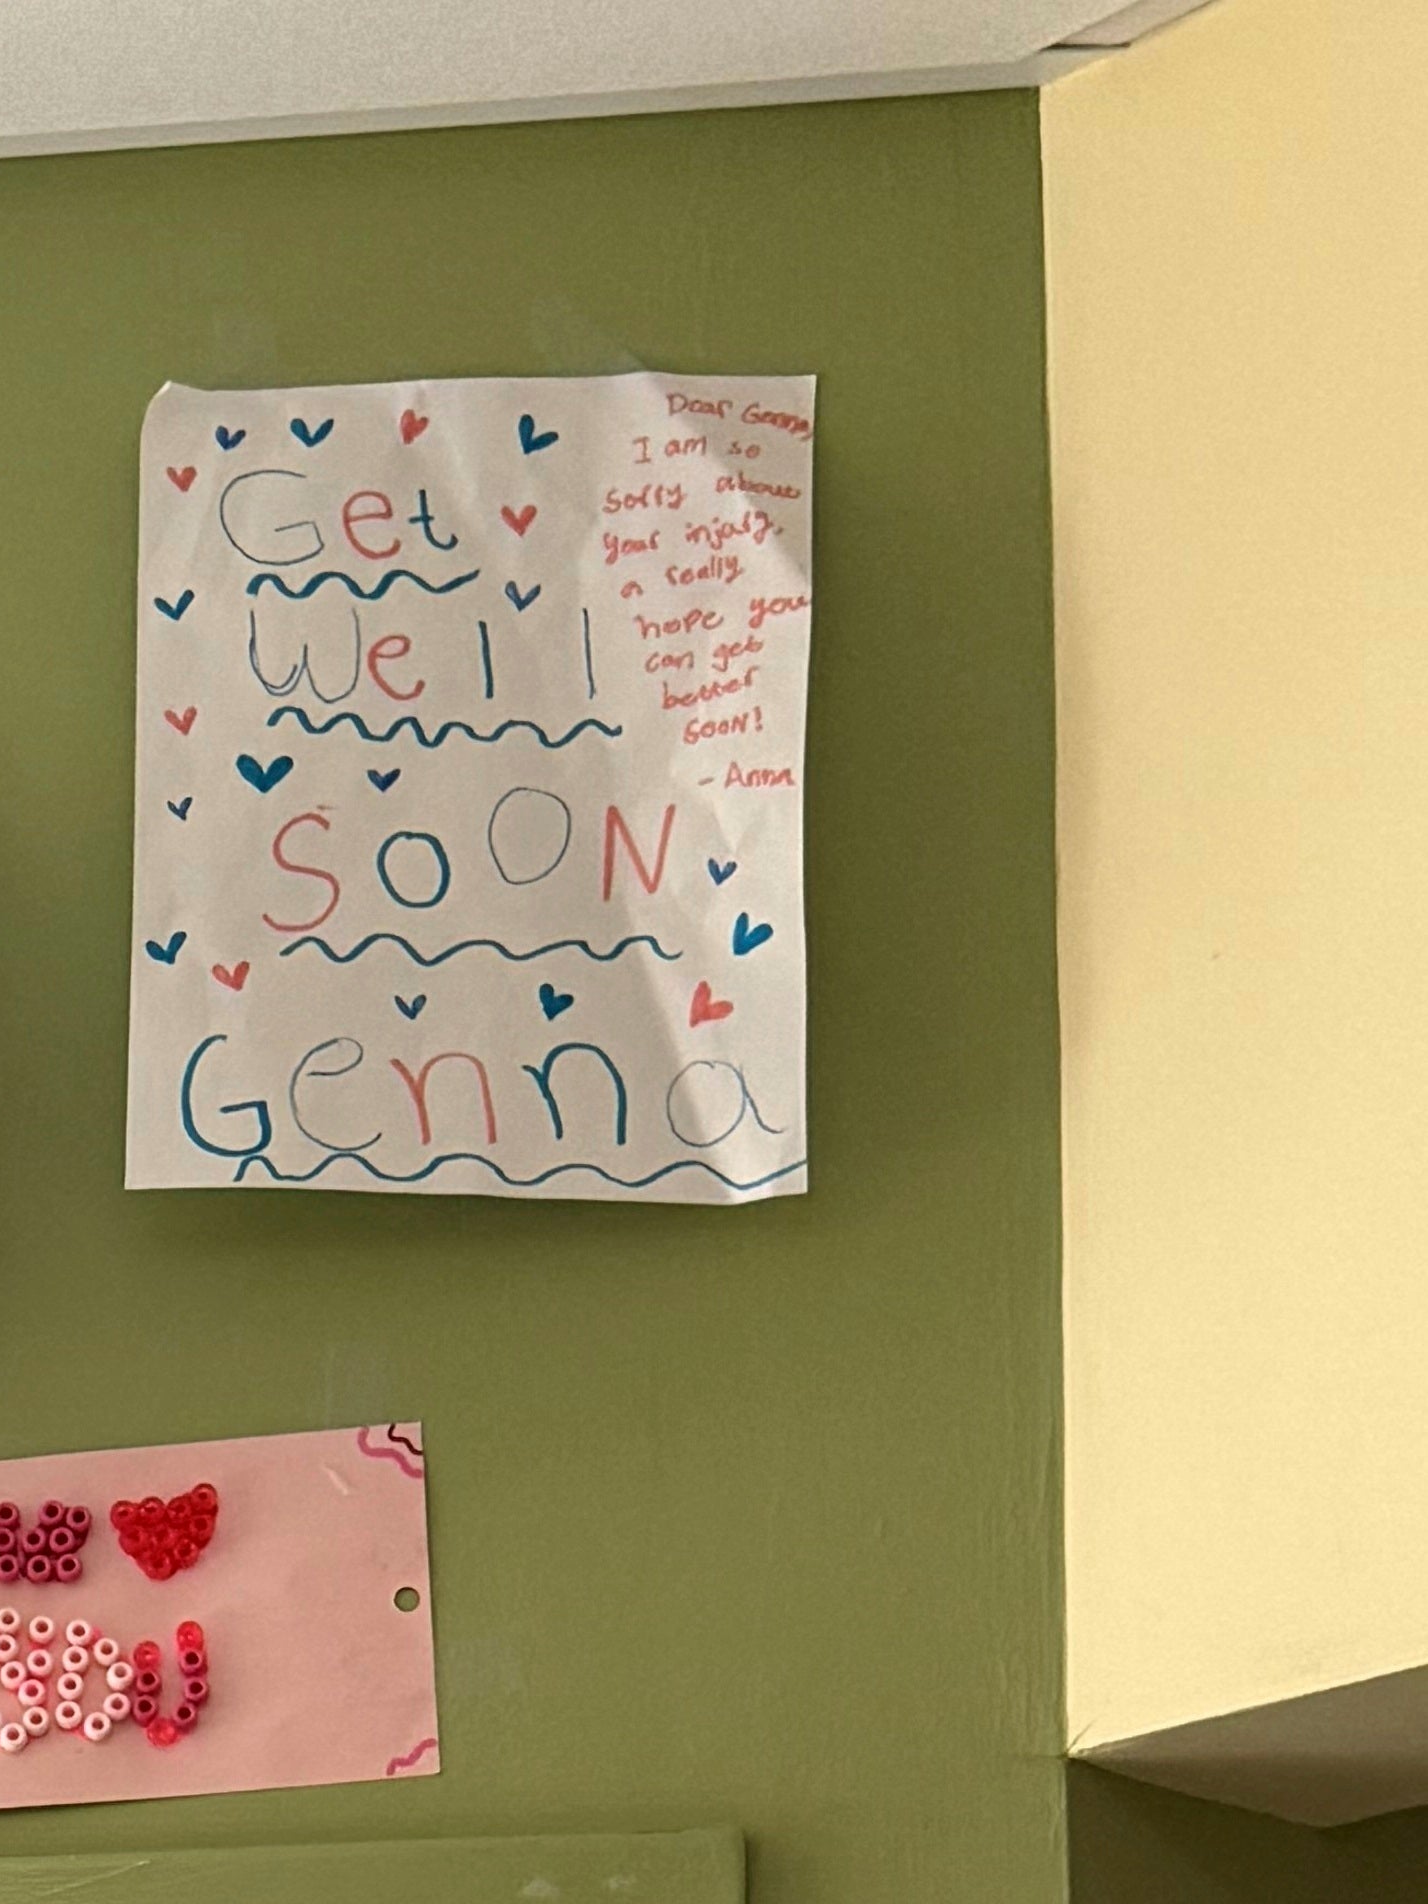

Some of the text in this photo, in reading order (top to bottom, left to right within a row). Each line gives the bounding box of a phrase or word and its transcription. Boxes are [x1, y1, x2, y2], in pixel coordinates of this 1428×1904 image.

[666, 392, 733, 418] Dear
[633, 436, 760, 463] I am so
[218, 468, 457, 566] Get
[748, 596, 809, 628] you
[645, 636, 764, 673] can get
[662, 666, 759, 709] better
[181, 1033, 786, 1158] Genna
